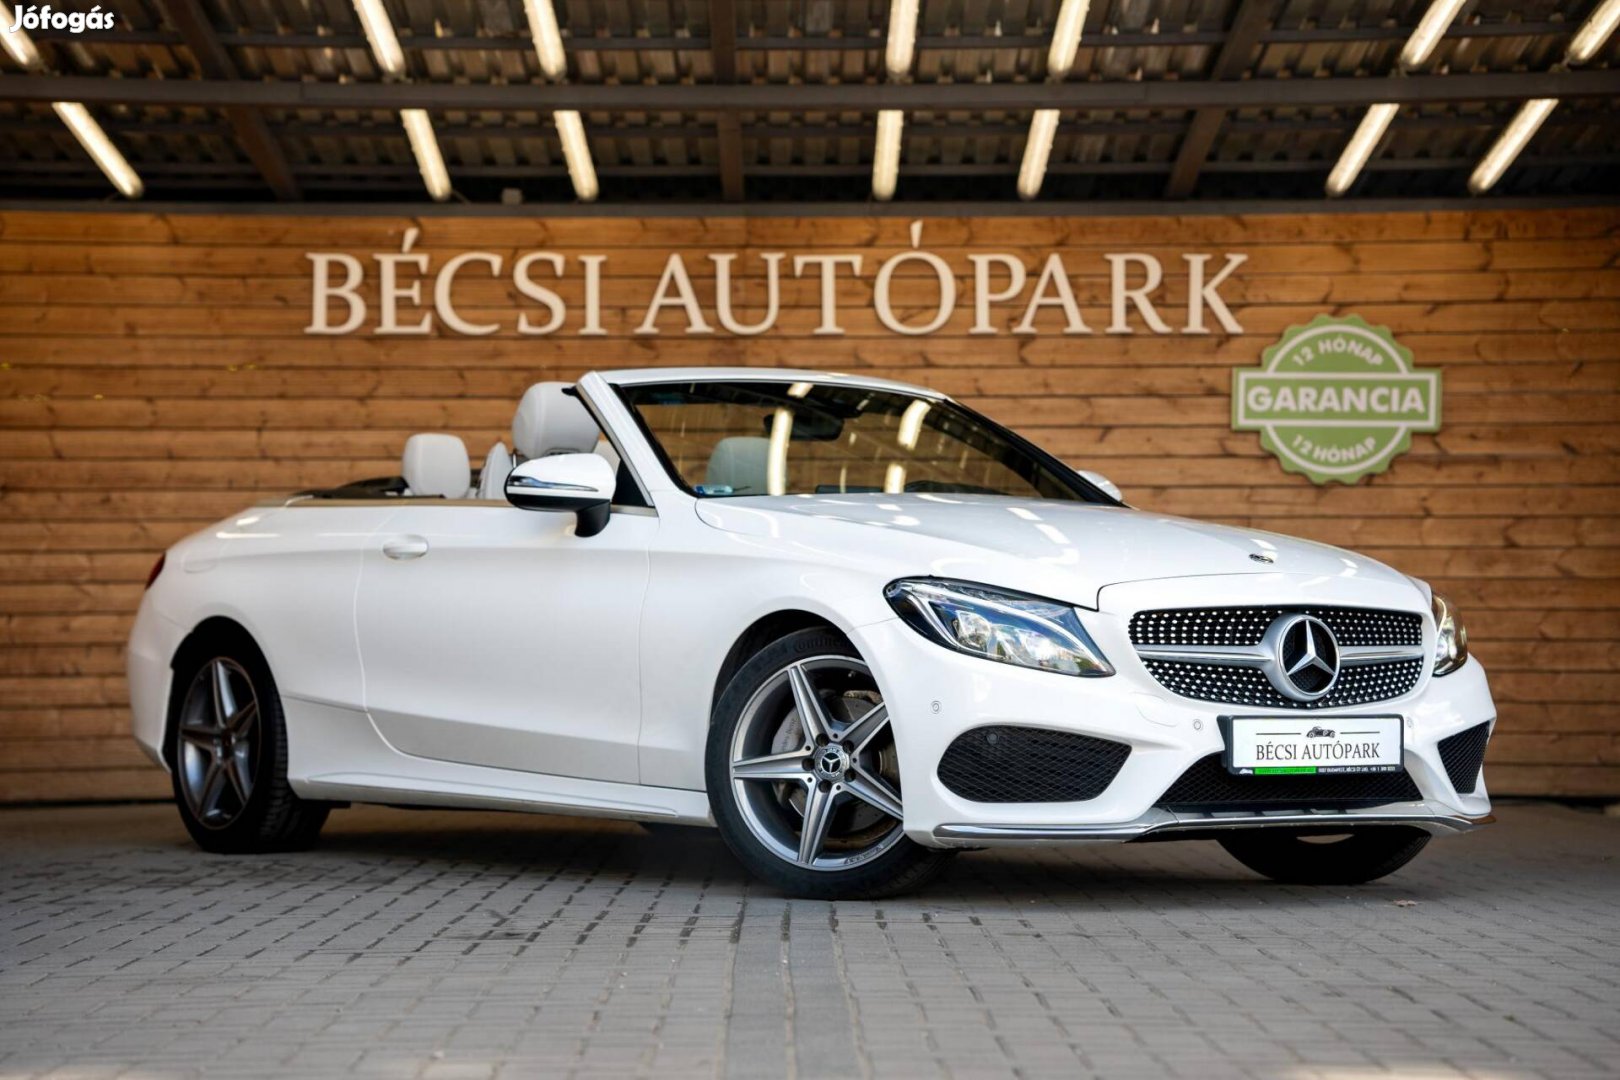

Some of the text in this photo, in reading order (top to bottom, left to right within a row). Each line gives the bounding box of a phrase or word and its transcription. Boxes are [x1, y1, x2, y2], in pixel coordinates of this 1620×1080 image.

[304, 220, 1249, 336] BÉCSI AUTÓPARK
[1292, 336, 1384, 366] 12 HÓNAP
[1247, 385, 1425, 414] GARANCIA
[1292, 434, 1377, 463] 12 HÓNAP
[1256, 740, 1380, 760] BÉCSI AUTÓPARK
